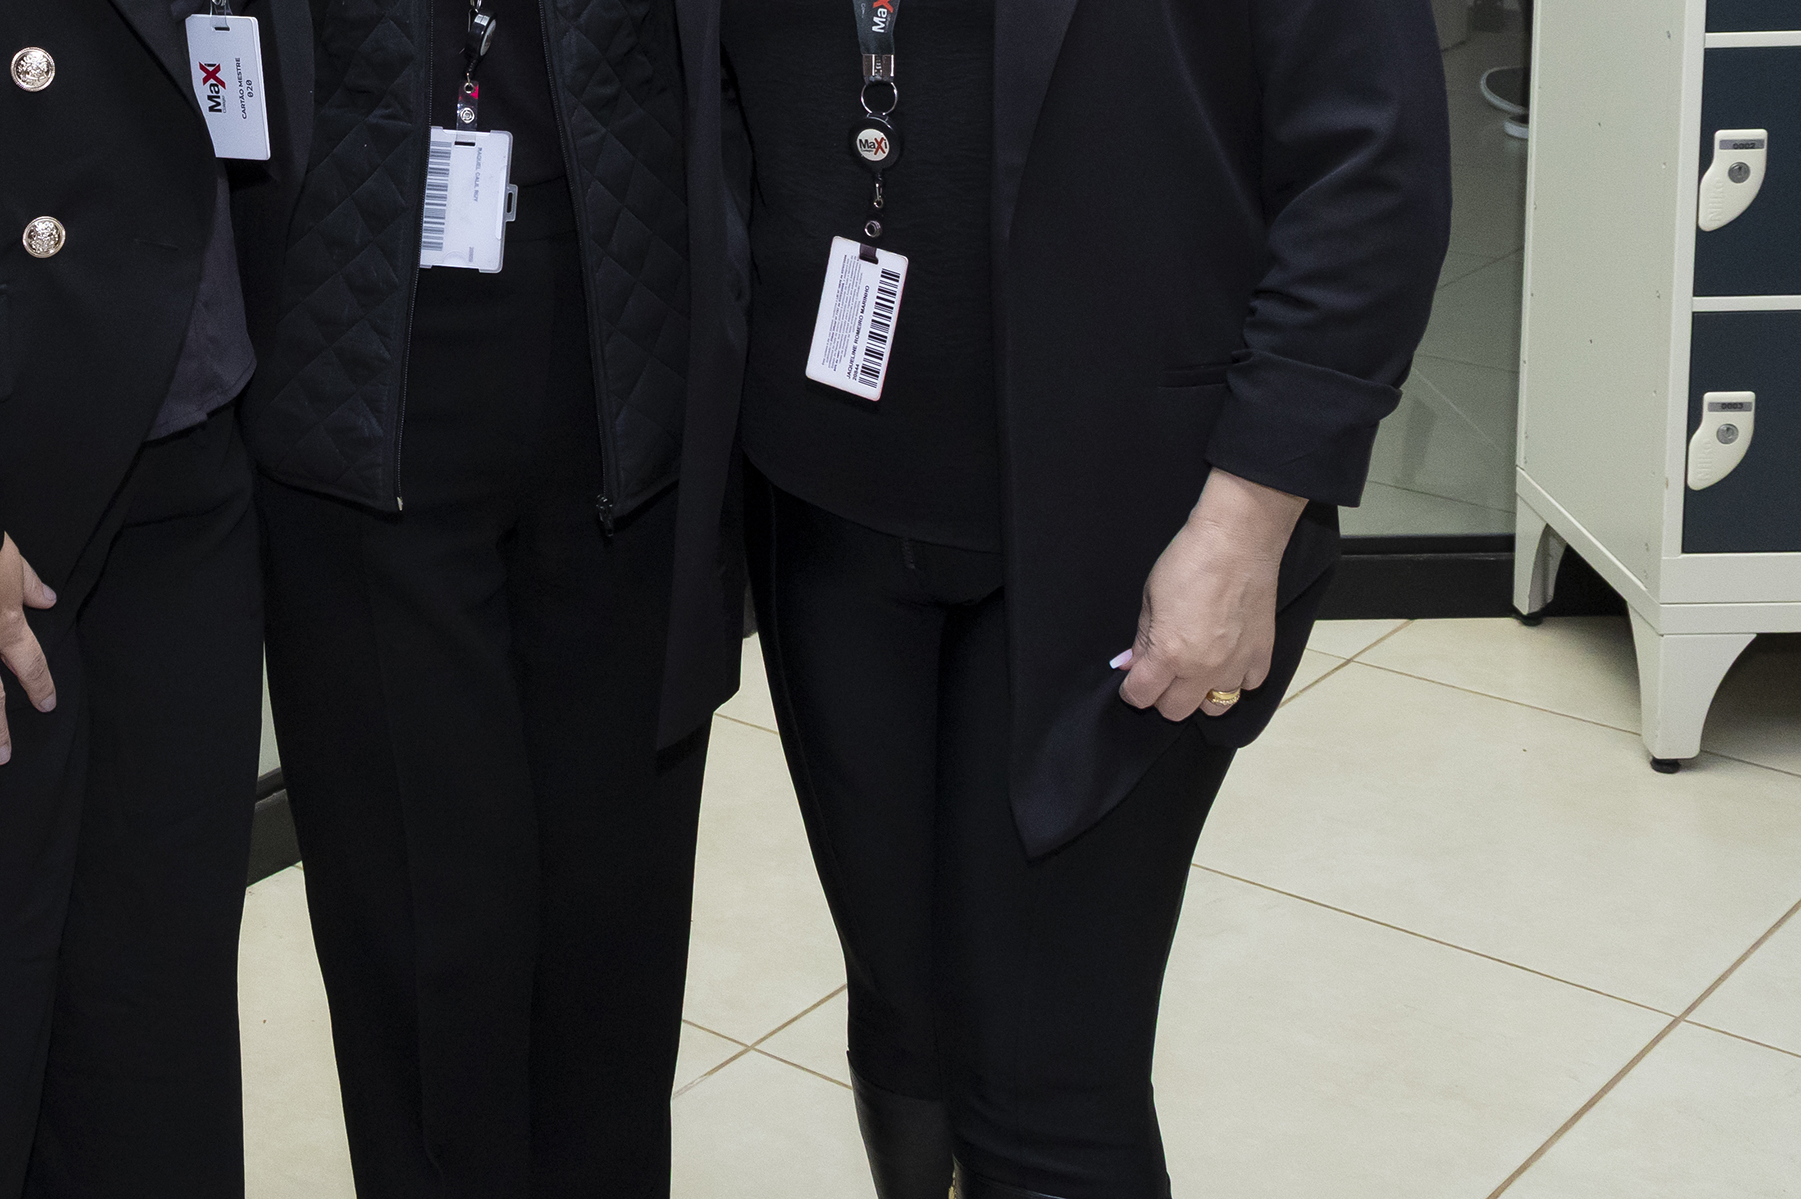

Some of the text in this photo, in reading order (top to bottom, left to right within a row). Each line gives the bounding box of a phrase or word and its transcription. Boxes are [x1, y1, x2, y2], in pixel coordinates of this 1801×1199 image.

[198, 61, 226, 114] MaXi
[235, 57, 248, 120] CARTÃO MESTRE
[858, 137, 889, 155] MaXi
[845, 285, 870, 379] JAQUELINE ROMEIRO MARINHO
